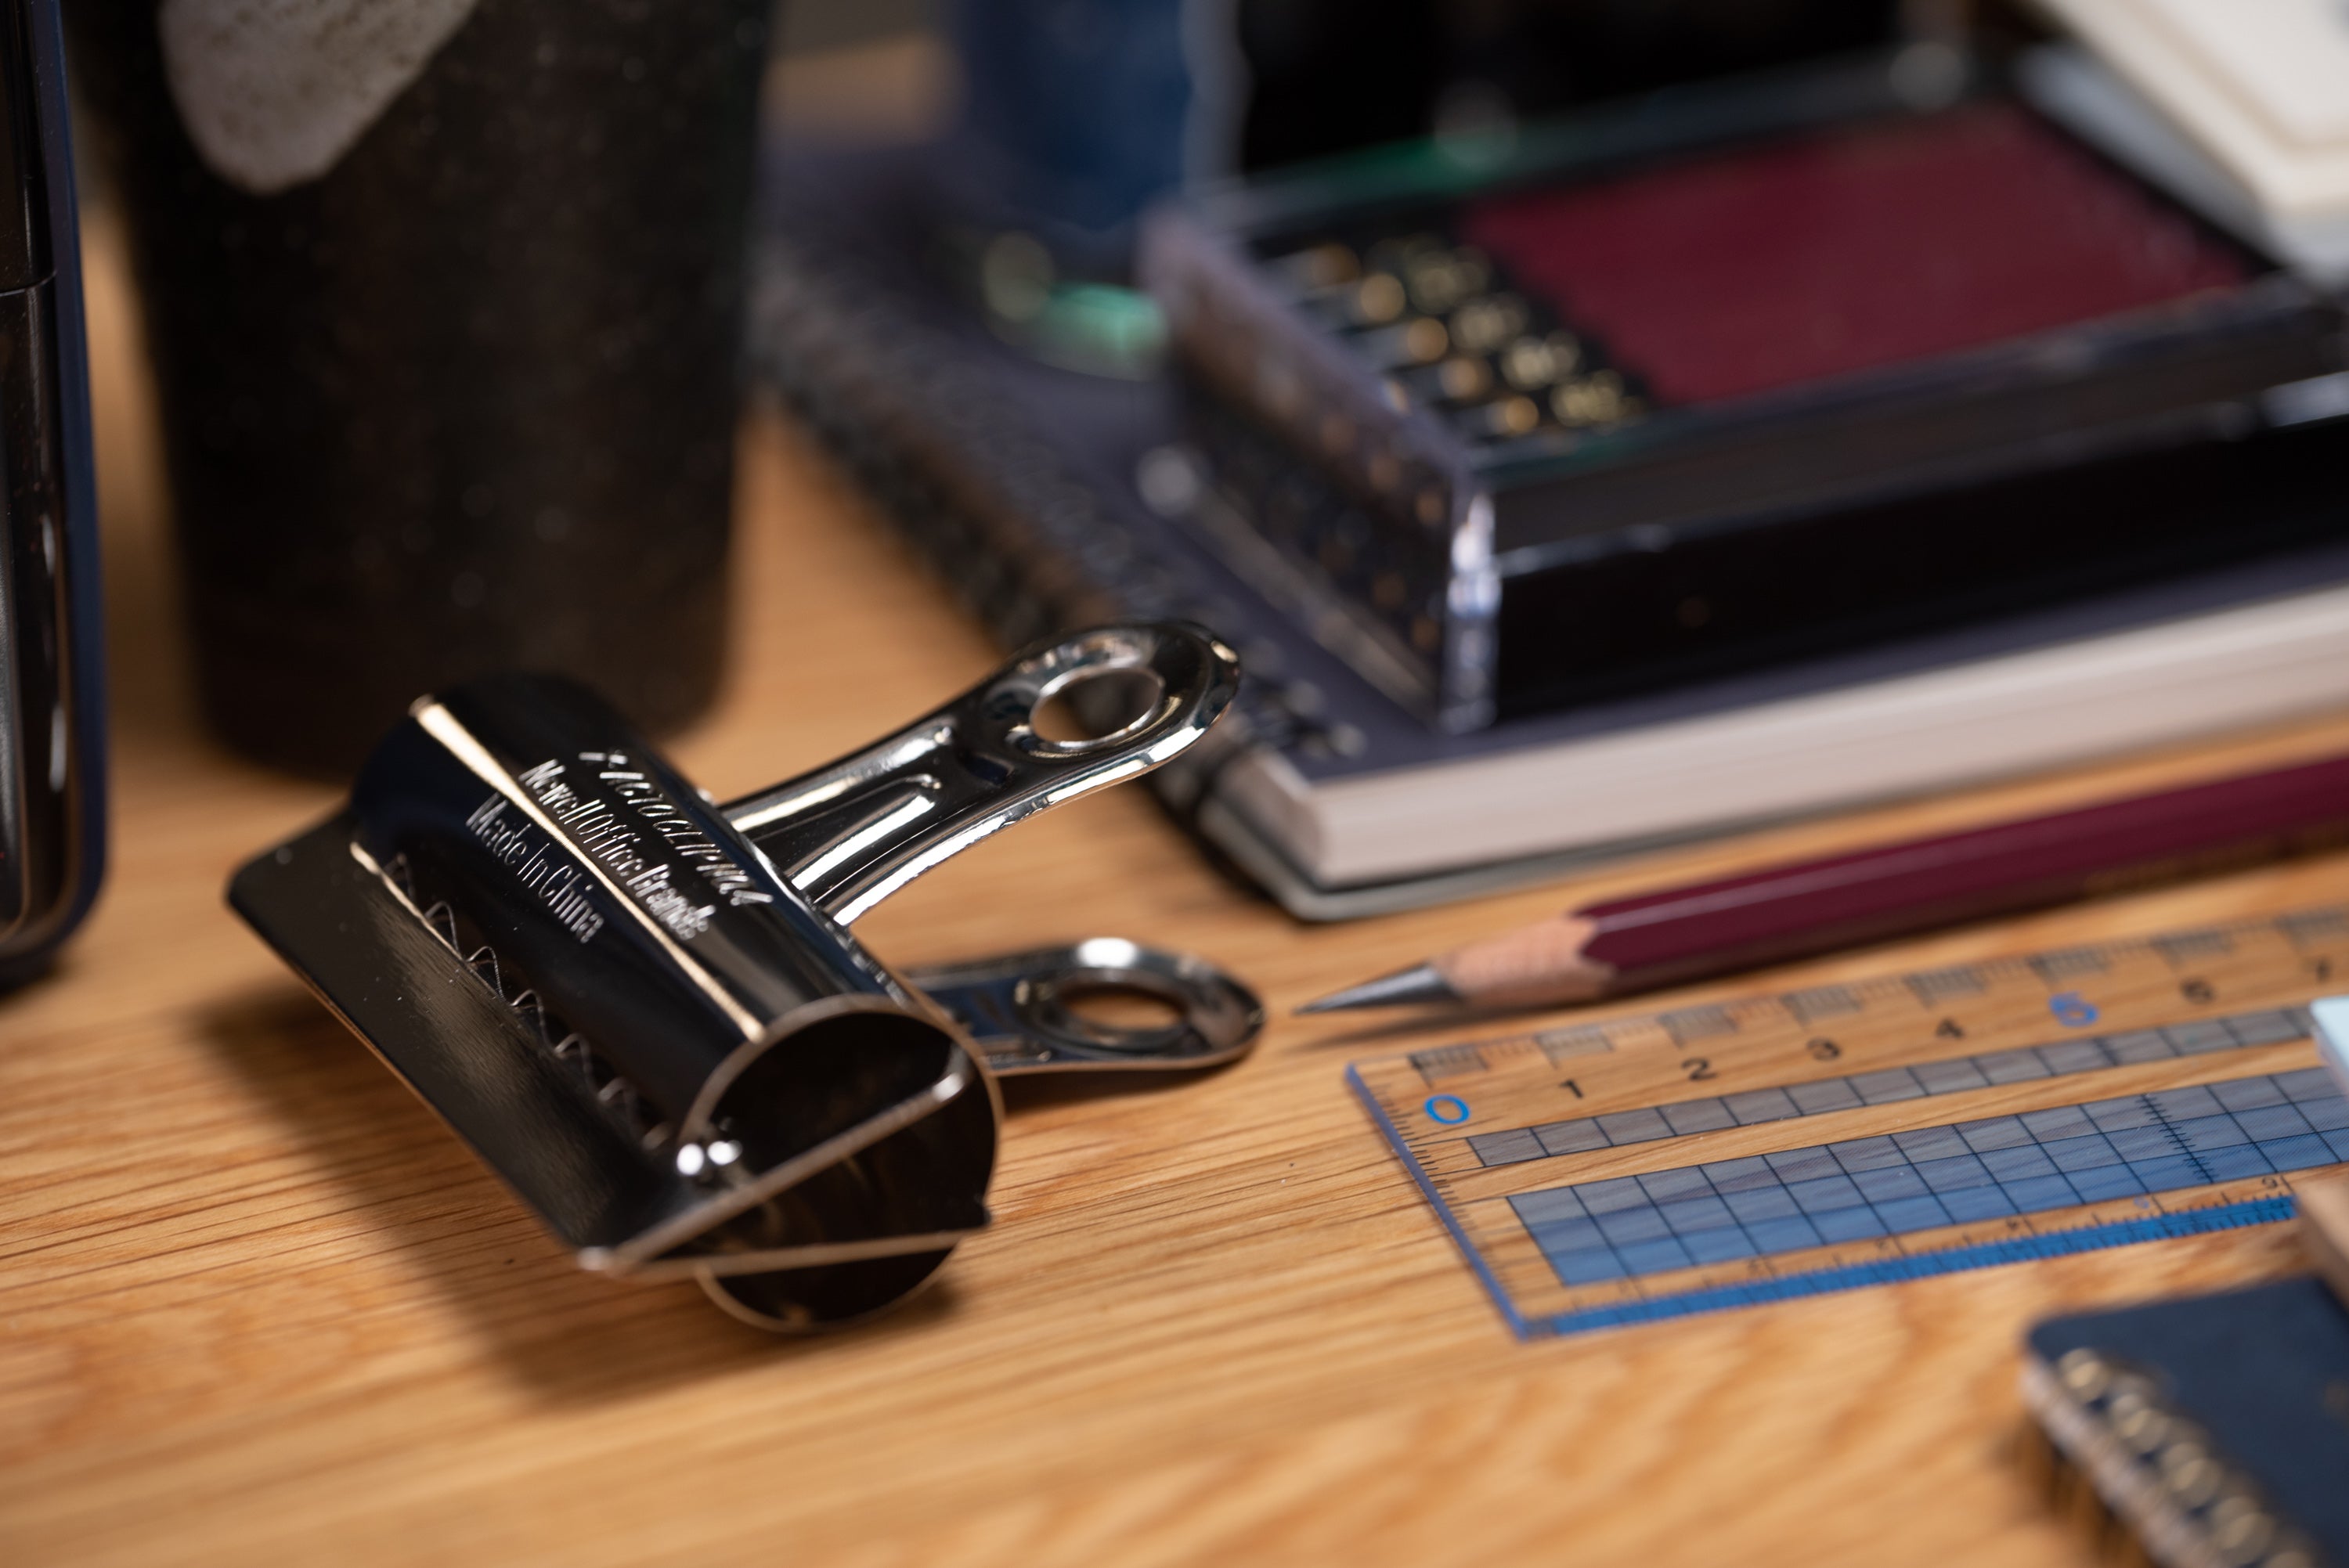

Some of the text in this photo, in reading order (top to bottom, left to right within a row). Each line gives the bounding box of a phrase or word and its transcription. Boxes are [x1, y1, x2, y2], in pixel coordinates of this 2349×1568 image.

[465, 791, 604, 944] Made In China
[1424, 1094, 1470, 1125] 0
[1560, 1079, 1584, 1099] 1
[1681, 1057, 1718, 1082] 2
[1806, 1036, 1842, 1062] 3
